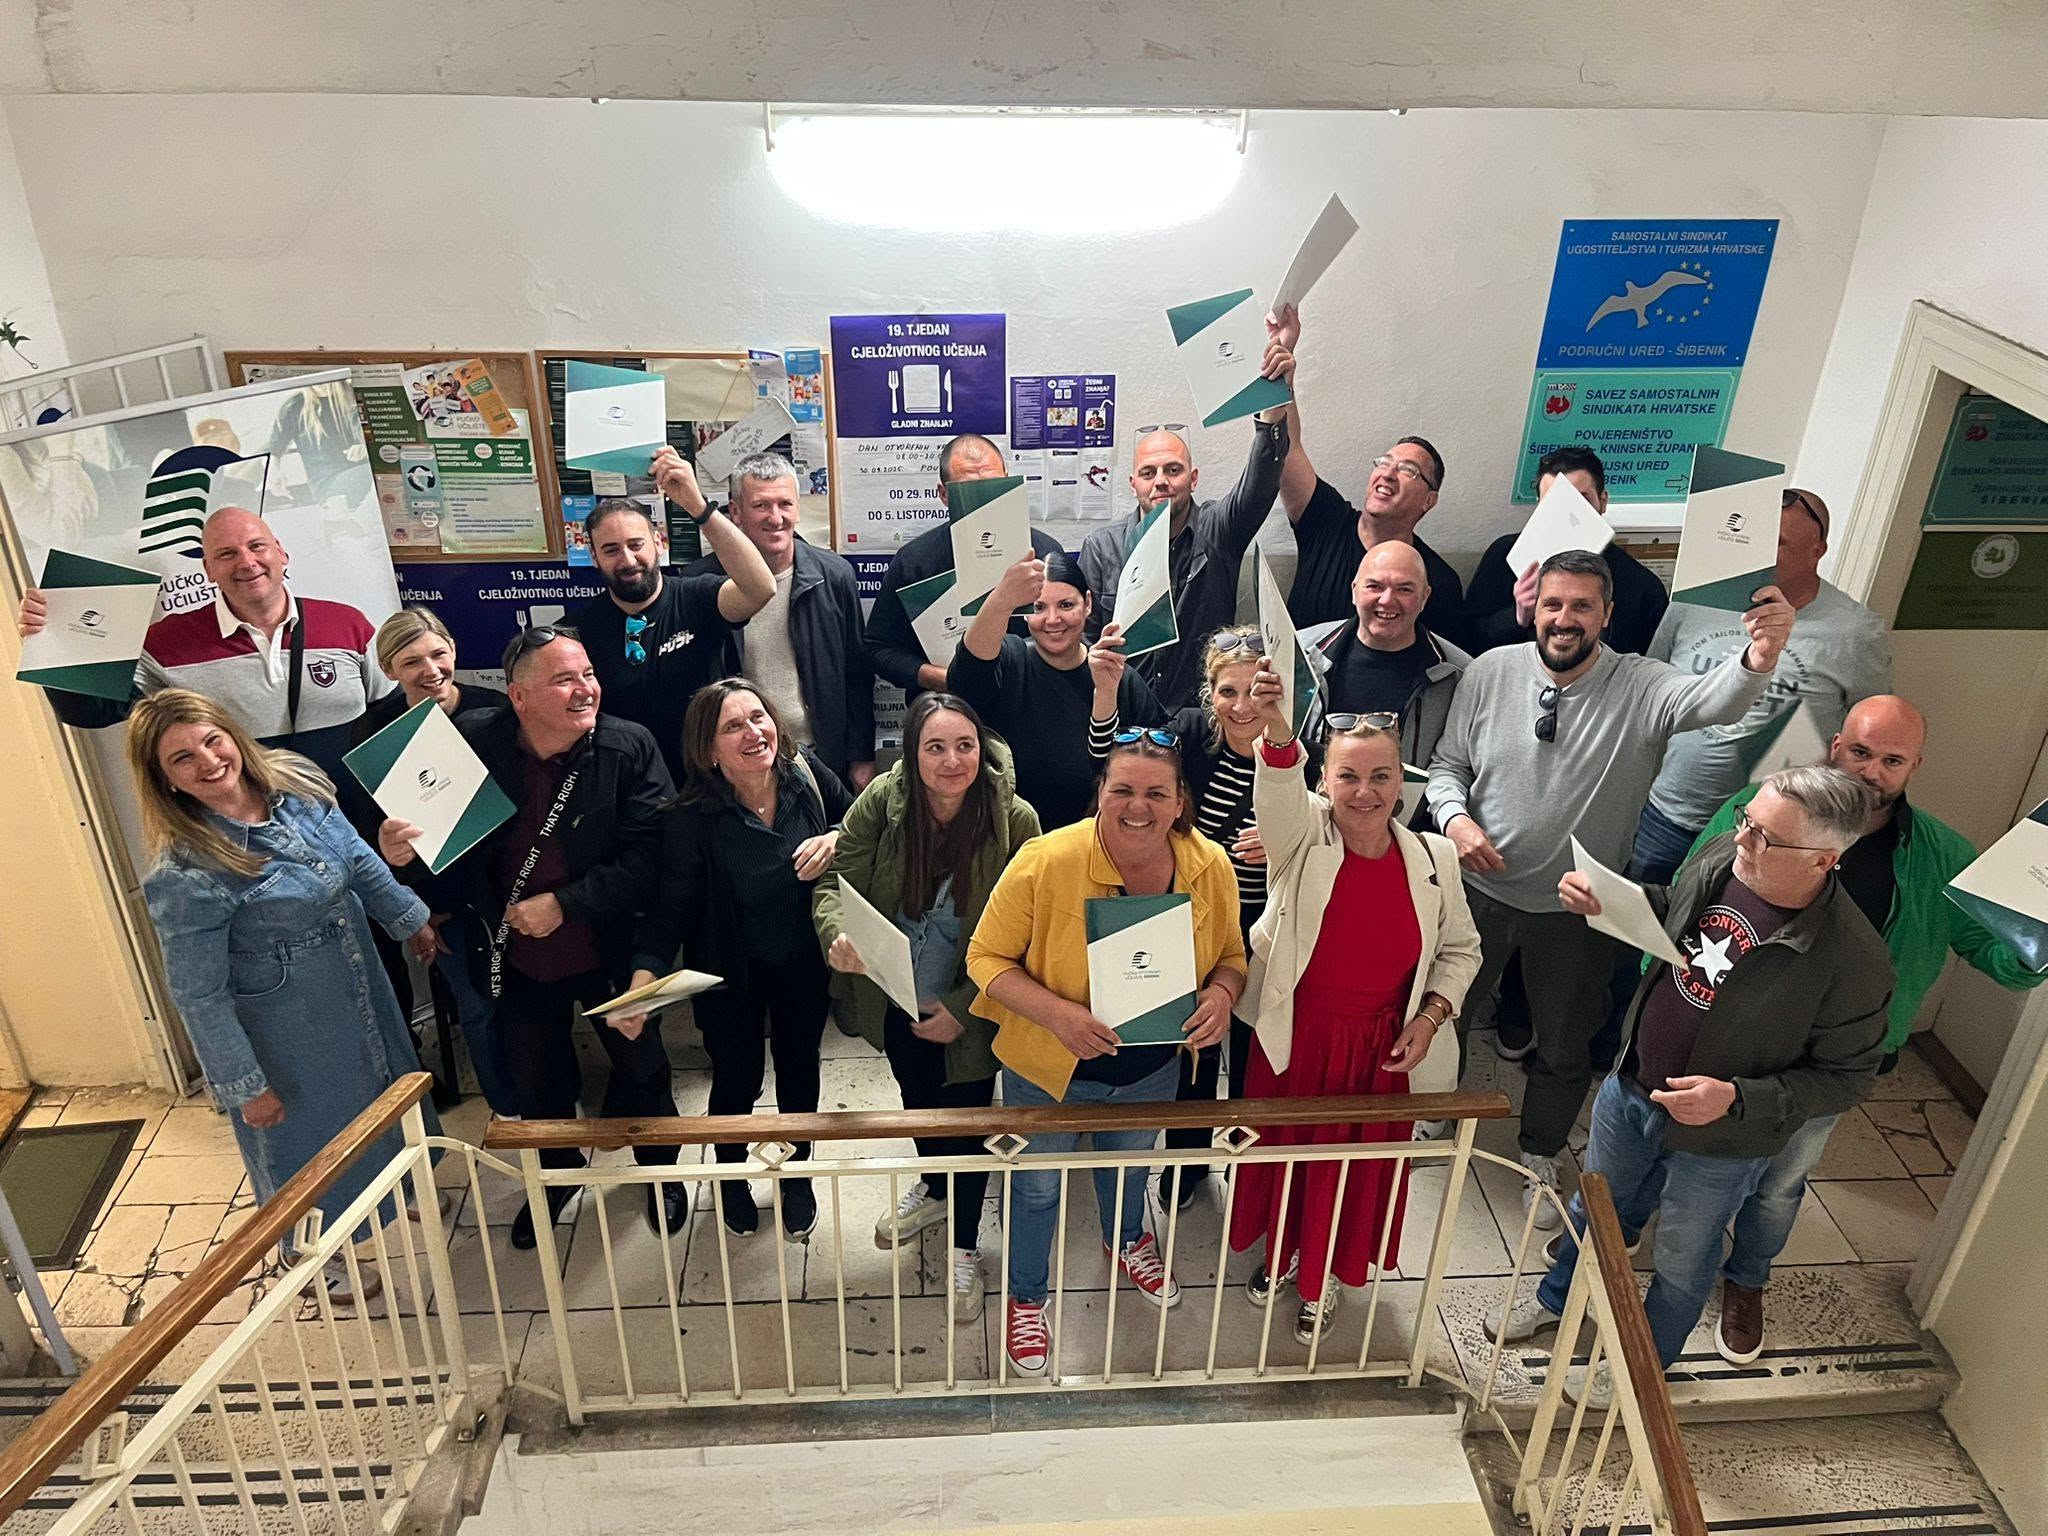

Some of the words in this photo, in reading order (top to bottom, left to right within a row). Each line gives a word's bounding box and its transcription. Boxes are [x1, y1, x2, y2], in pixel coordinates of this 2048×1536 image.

[1611, 231, 1678, 241] SAMOSTALNI
[1680, 231, 1728, 241] SINDIKAT
[1567, 245, 1656, 255] UGOSTITELJSTVA
[1665, 245, 1709, 254] TURIZMA
[1711, 245, 1766, 254] HRVATSKE
[887, 324, 904, 336] 19.
[906, 324, 950, 336] TJEDAN
[851, 343, 940, 359] CJELOŽIVOTNOG
[943, 342, 987, 357] UČENJA
[1558, 345, 1626, 356] PODRUČNI
[1629, 346, 1665, 356] URED
[1675, 342, 1727, 356] ŠIBENIK
[1585, 389, 1627, 399] SAVEZ
[1629, 389, 1720, 399] SAMOSTALNIH
[1582, 404, 1647, 414] SINDIKATA
[1650, 404, 1717, 414] HRVATSKE
[891, 419, 919, 429] GLADNI
[920, 419, 953, 429] ZNANJA?
[1574, 429, 1673, 440] POVJERENIŠTVO
[858, 444, 878, 452] DAN
[1600, 443, 1653, 454] KNINSKE
[1636, 460, 1670, 471] URED
[889, 489, 904, 500] OD
[906, 489, 922, 499] 29.
[868, 510, 882, 520] DO
[885, 510, 894, 520] 5.
[857, 562, 889, 573] TJEDA
[510, 570, 527, 581] 19.
[528, 569, 570, 580] TJEDAN
[161, 585, 218, 612] UČILIŠT
[401, 589, 443, 600] UČENJA
[478, 586, 564, 600] CJELOŽIVOTNOG
[1691, 637, 1708, 652] TOM
[1709, 629, 1741, 640] TAILOR
[539, 802, 565, 837] THAT'S
[509, 878, 526, 905] HAT'S
[519, 846, 541, 879] RIGHT
